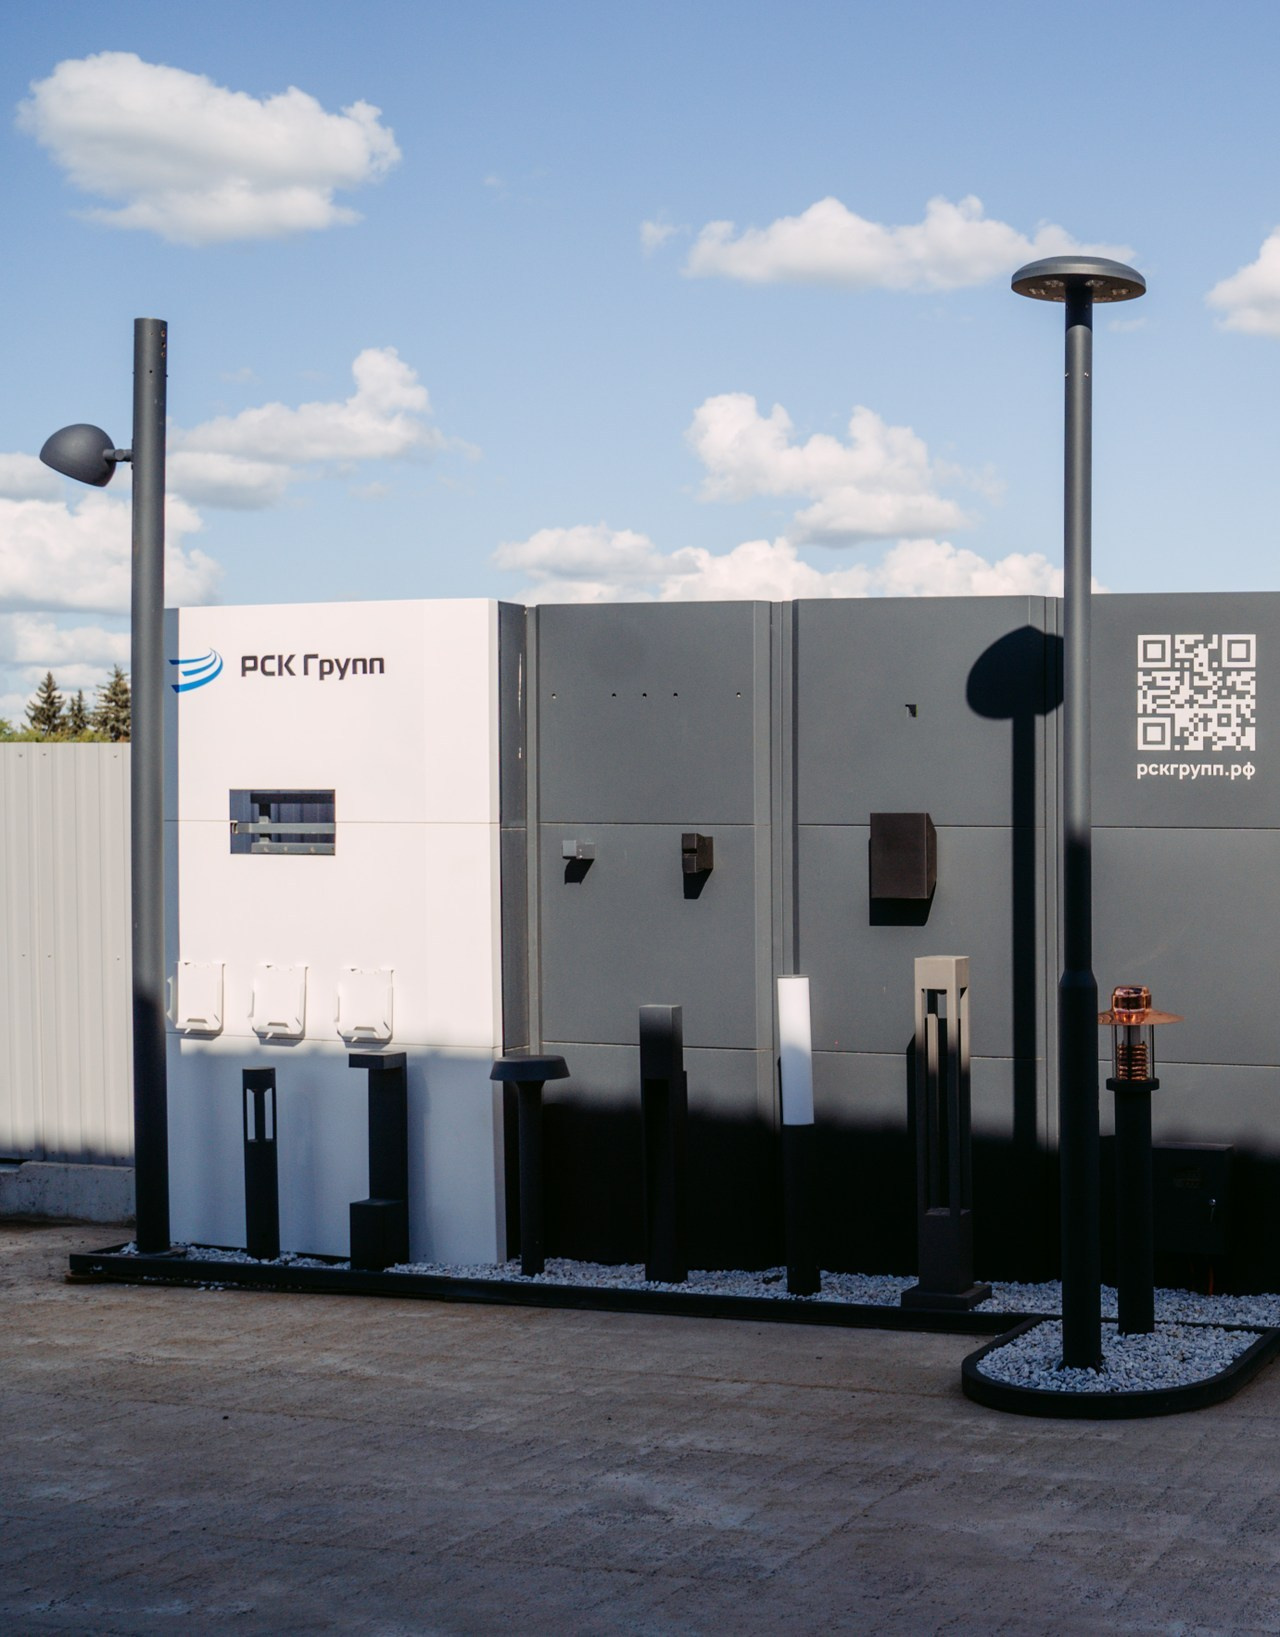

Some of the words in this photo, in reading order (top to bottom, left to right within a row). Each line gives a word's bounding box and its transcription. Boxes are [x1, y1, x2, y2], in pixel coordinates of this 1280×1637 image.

[241, 654, 296, 677] РСК
[303, 653, 385, 681] Групп
[1136, 761, 1256, 780] рскгрупп.рф
